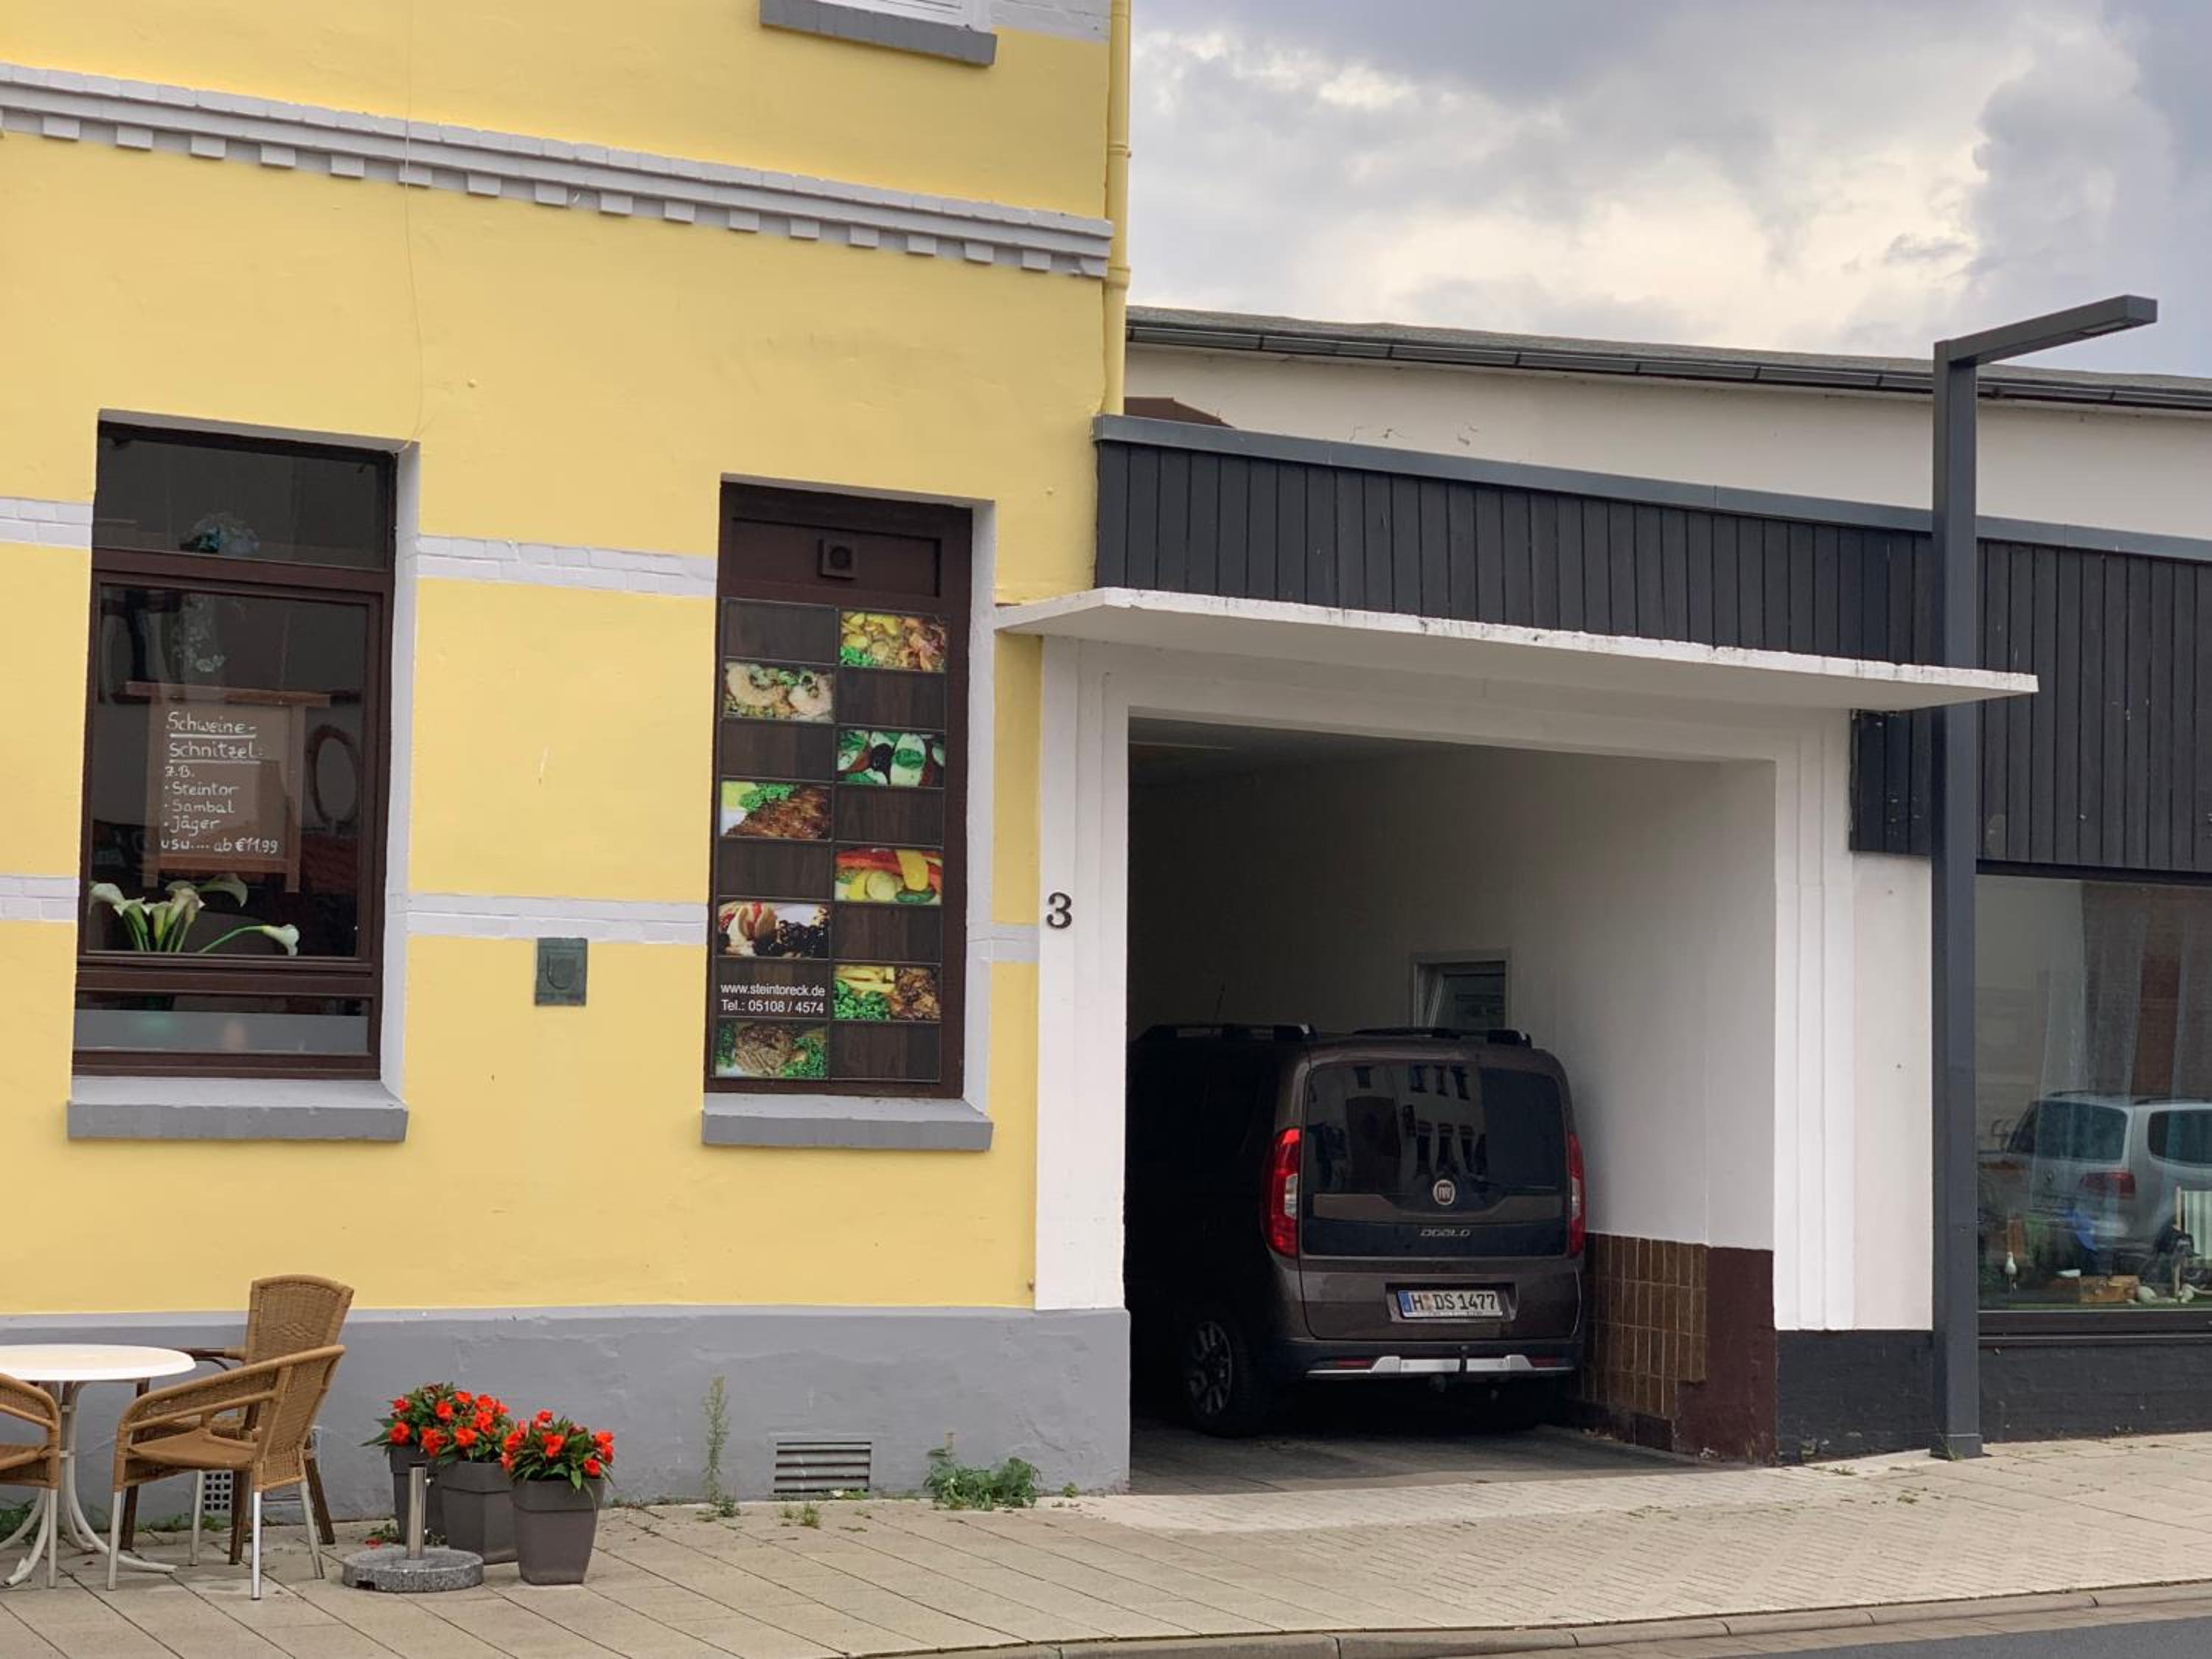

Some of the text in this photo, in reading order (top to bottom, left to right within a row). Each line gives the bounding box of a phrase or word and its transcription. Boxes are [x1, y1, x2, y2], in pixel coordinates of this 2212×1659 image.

[167, 712, 257, 733] Schweine-
[214, 838, 232, 852] ab
[1046, 891, 1073, 930] 3
[720, 983, 826, 996] www.steintoreck.de
[720, 999, 745, 1011] Tel.:
[748, 1000, 785, 1012] 05108
[795, 1001, 824, 1014] 4574
[1411, 1295, 1425, 1310] H
[1458, 1294, 1495, 1310] 1477
